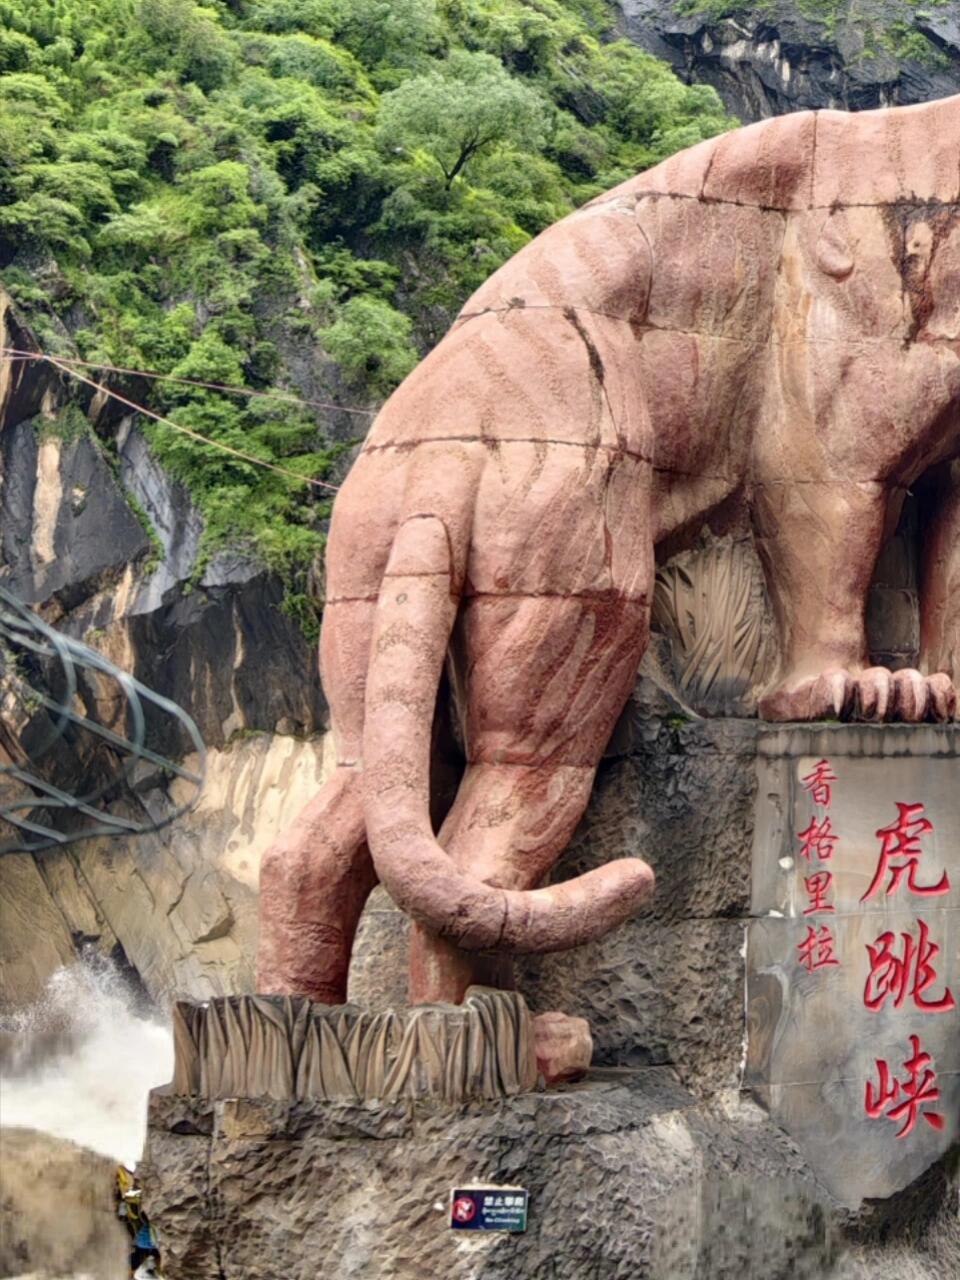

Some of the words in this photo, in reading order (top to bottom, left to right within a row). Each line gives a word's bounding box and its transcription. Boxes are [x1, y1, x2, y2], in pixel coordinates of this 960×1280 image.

[797, 758, 840, 974] 香格里拉
[859, 801, 955, 1138] 虎跳峡
